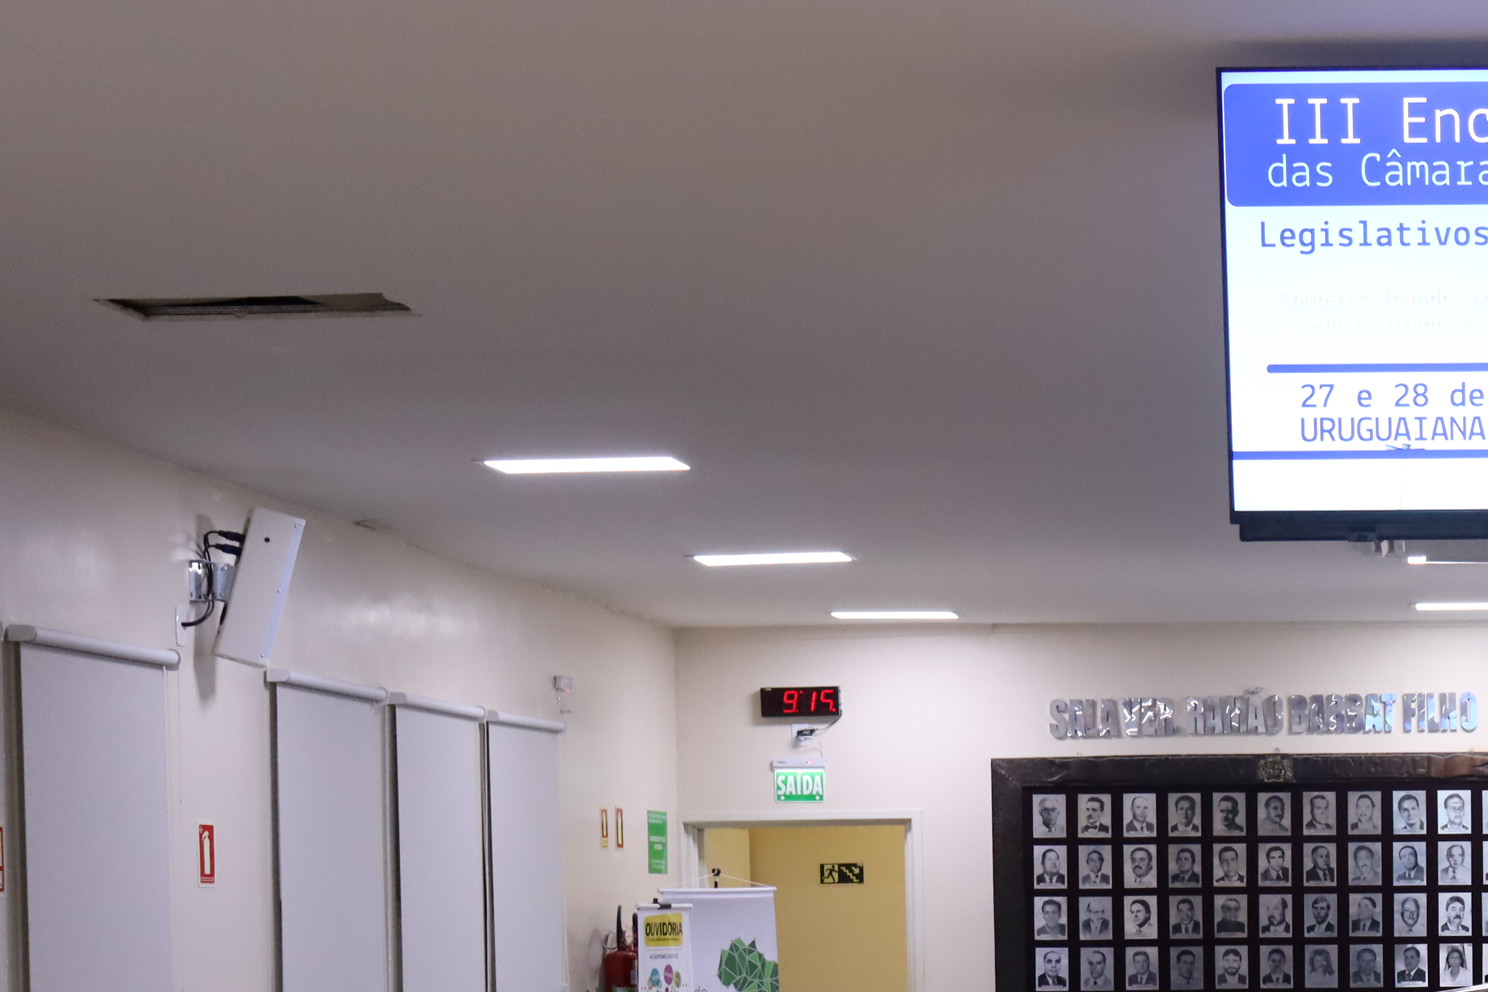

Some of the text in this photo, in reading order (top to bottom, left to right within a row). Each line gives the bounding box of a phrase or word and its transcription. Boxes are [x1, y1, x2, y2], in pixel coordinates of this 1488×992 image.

[1275, 97, 1361, 145] III
[1267, 153, 1334, 188] das
[1300, 384, 1335, 408] 27
[1356, 388, 1373, 408] e
[1394, 383, 1430, 408] 28
[1449, 382, 1485, 407] de
[1300, 416, 1487, 442] URUGUAIANA
[1049, 699, 1120, 739] SALA
[1402, 692, 1479, 733] FILHO
[645, 922, 683, 937] OUVIDORIA
